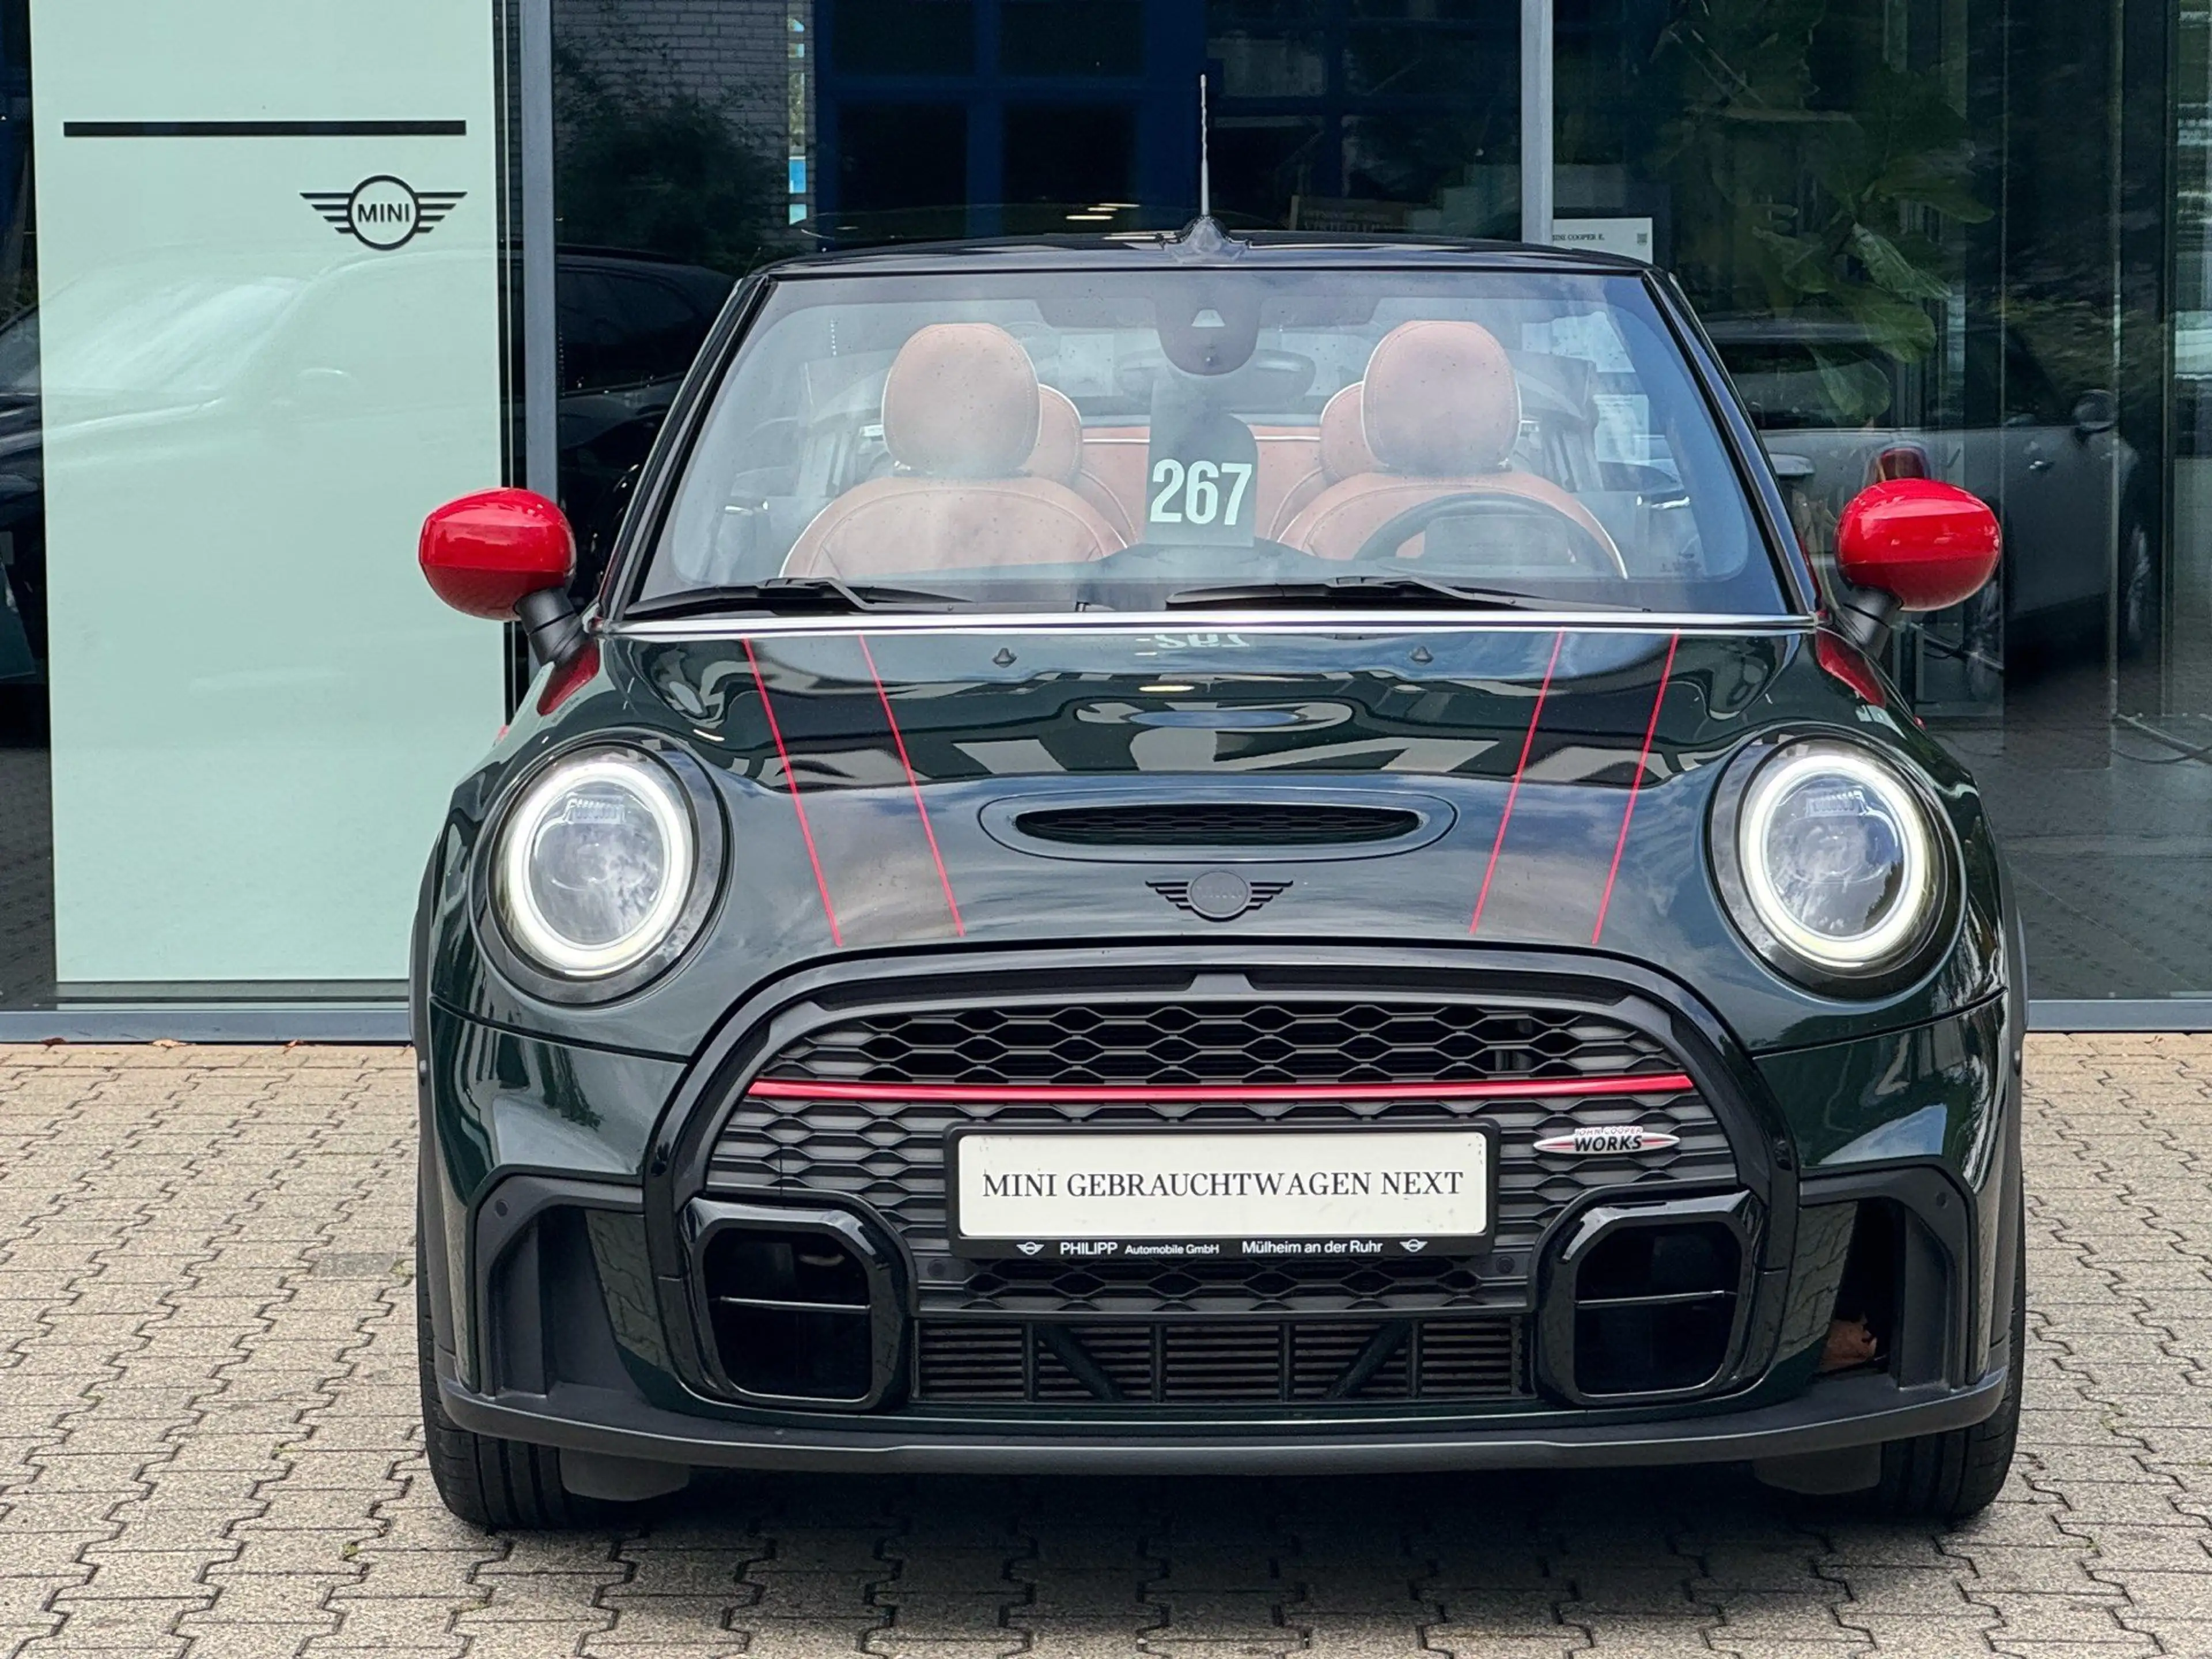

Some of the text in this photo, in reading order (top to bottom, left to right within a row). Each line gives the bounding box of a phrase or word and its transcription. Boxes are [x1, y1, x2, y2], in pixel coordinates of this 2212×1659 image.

[358, 203, 410, 222] MINI
[1150, 459, 1253, 525] 267
[1575, 1126, 1642, 1136] JOHN COOPER
[1574, 1135, 1642, 1152] WORKS
[982, 1172, 1464, 1197] MINI GEBRAUCHTWAGEN NEXT
[1060, 1240, 1383, 1255] PHILIPP Automobile GmbH Mülheim an der Ruhr
